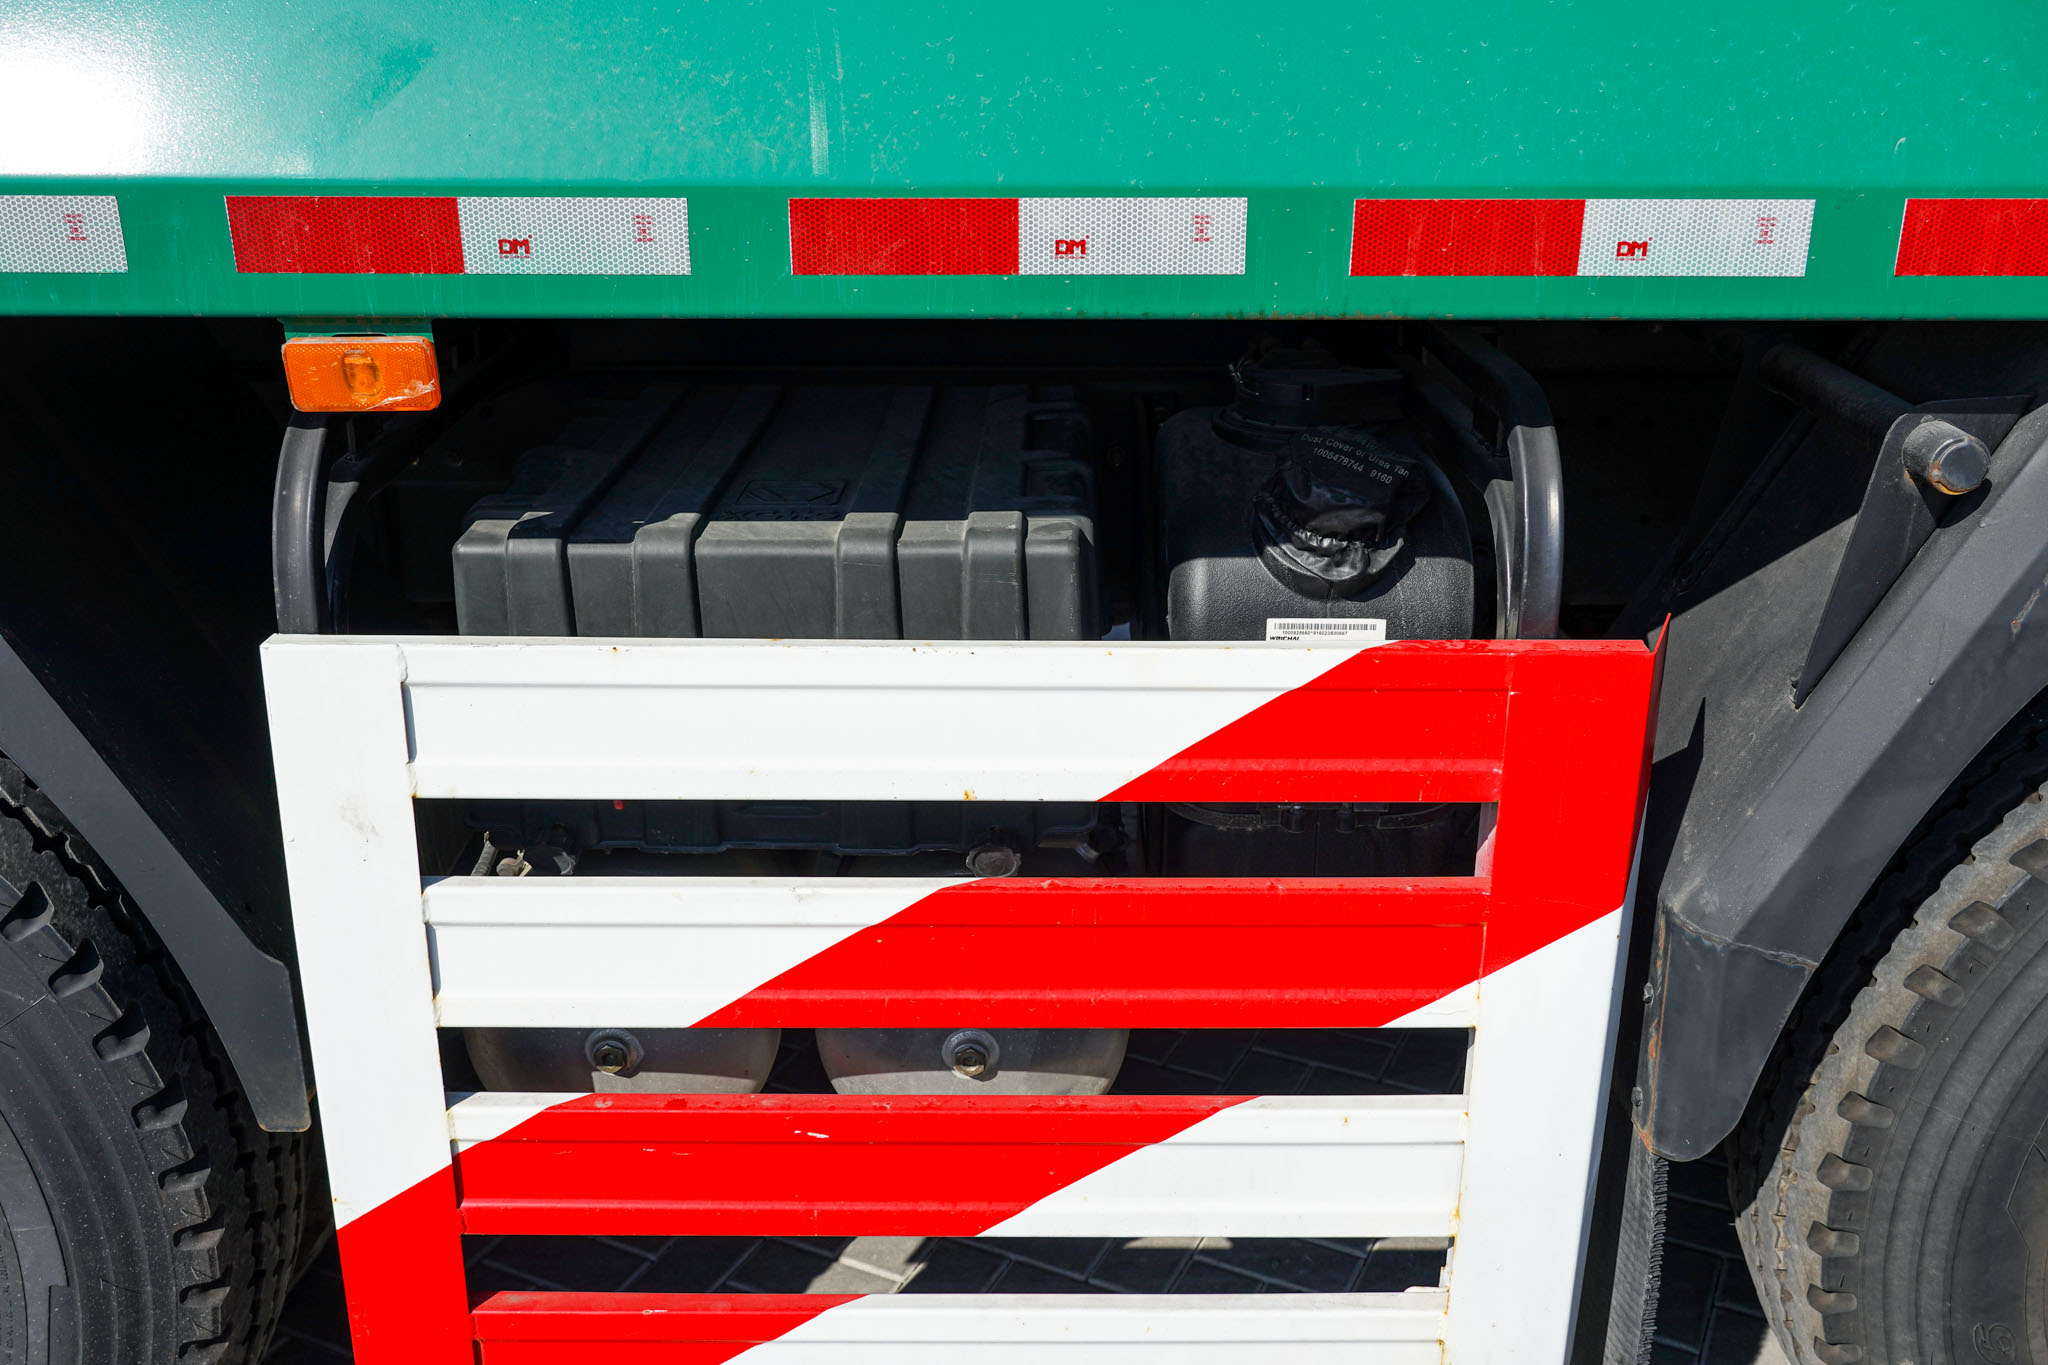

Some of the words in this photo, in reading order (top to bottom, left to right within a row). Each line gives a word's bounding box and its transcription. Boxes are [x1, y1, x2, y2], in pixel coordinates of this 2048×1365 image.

[498, 238, 531, 255] DM
[1055, 239, 1087, 255] DM
[1616, 241, 1649, 257] DM
[1369, 469, 1393, 484] 9160
